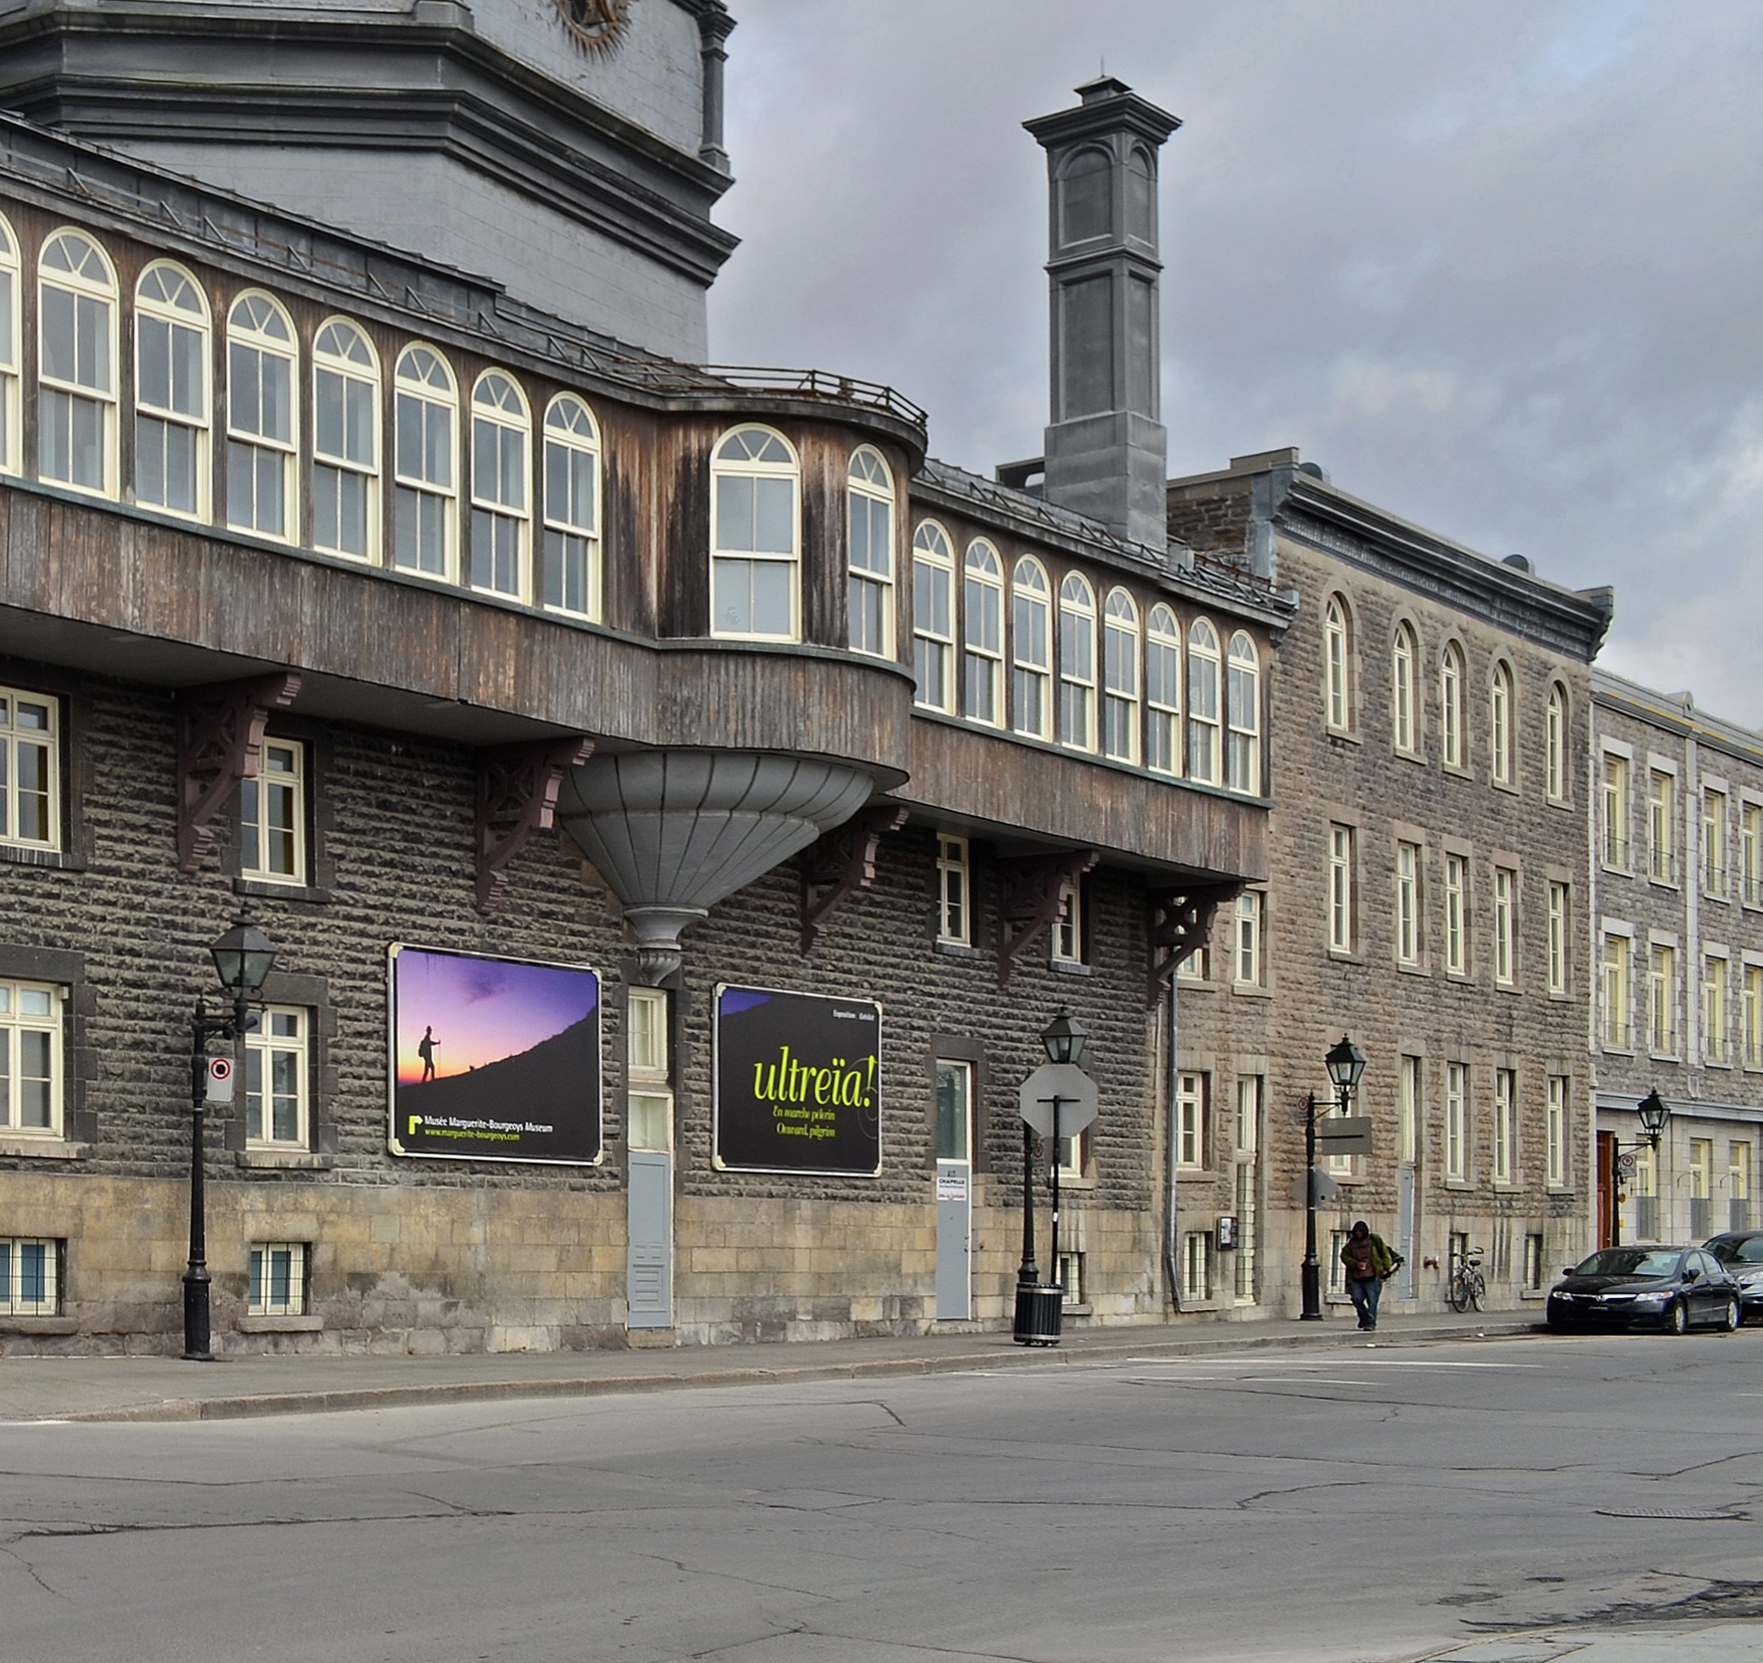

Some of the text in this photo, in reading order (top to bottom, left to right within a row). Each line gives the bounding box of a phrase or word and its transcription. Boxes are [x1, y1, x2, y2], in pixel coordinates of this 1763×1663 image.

[754, 1046, 875, 1107] ultreïa!
[772, 1105, 783, 1117] En
[784, 1107, 810, 1119] marche
[424, 1115, 553, 1132] Musée Marguerite-Bourgeoys Museum
[777, 1122, 836, 1140] Onward, pilgrim
[424, 1129, 520, 1141] www.marguerite-bourgeoys.com
